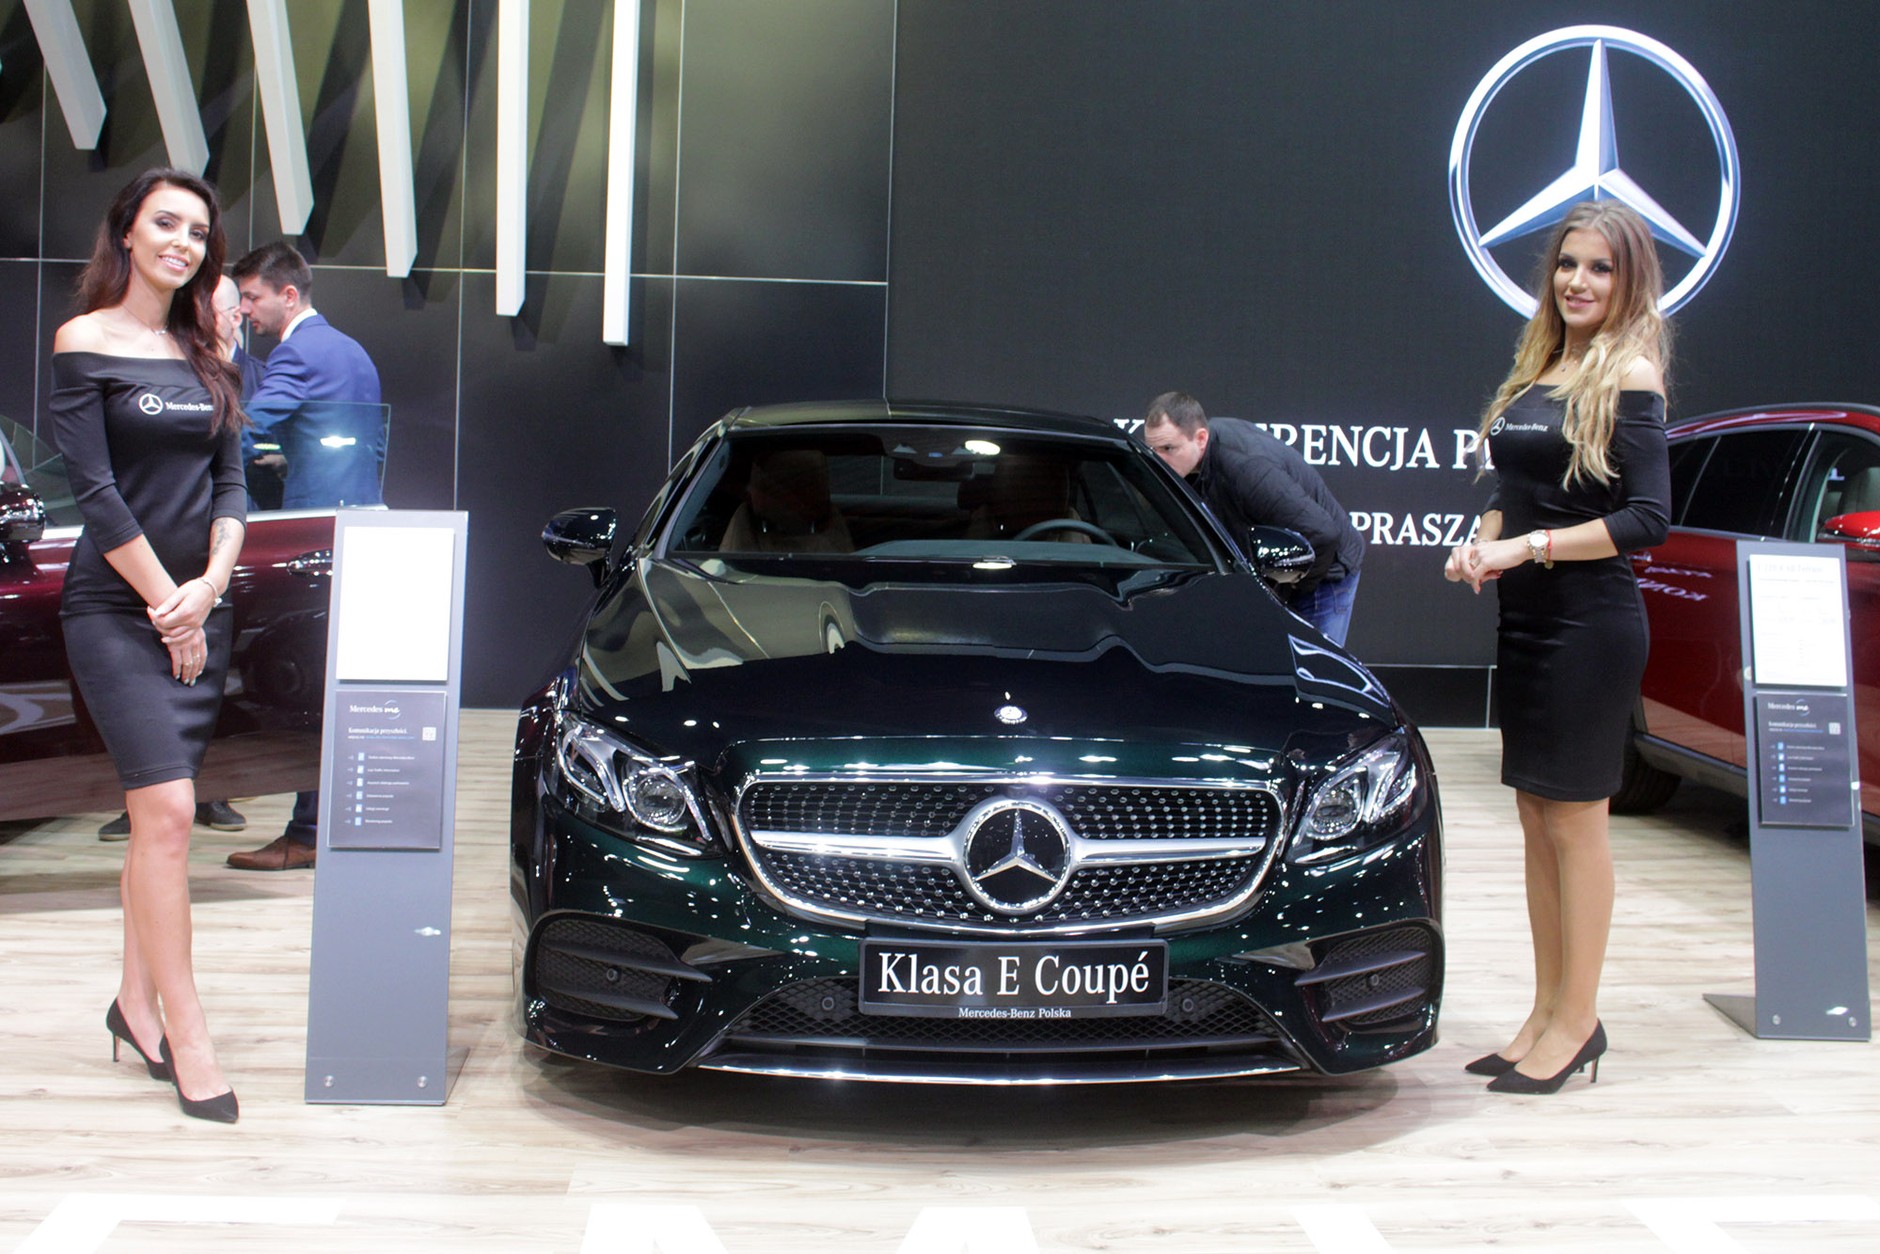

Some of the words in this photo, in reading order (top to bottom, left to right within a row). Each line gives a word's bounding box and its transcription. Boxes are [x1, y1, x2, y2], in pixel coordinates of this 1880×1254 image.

[165, 401, 214, 411] Mercedes-Ben
[349, 704, 383, 713] Mercedes
[877, 951, 984, 996] Klasa
[996, 956, 1021, 996] E
[1034, 951, 1150, 1005] Coupé
[958, 1007, 1036, 1019] Mercedes-Benz
[1038, 1008, 1072, 1018] Polska
